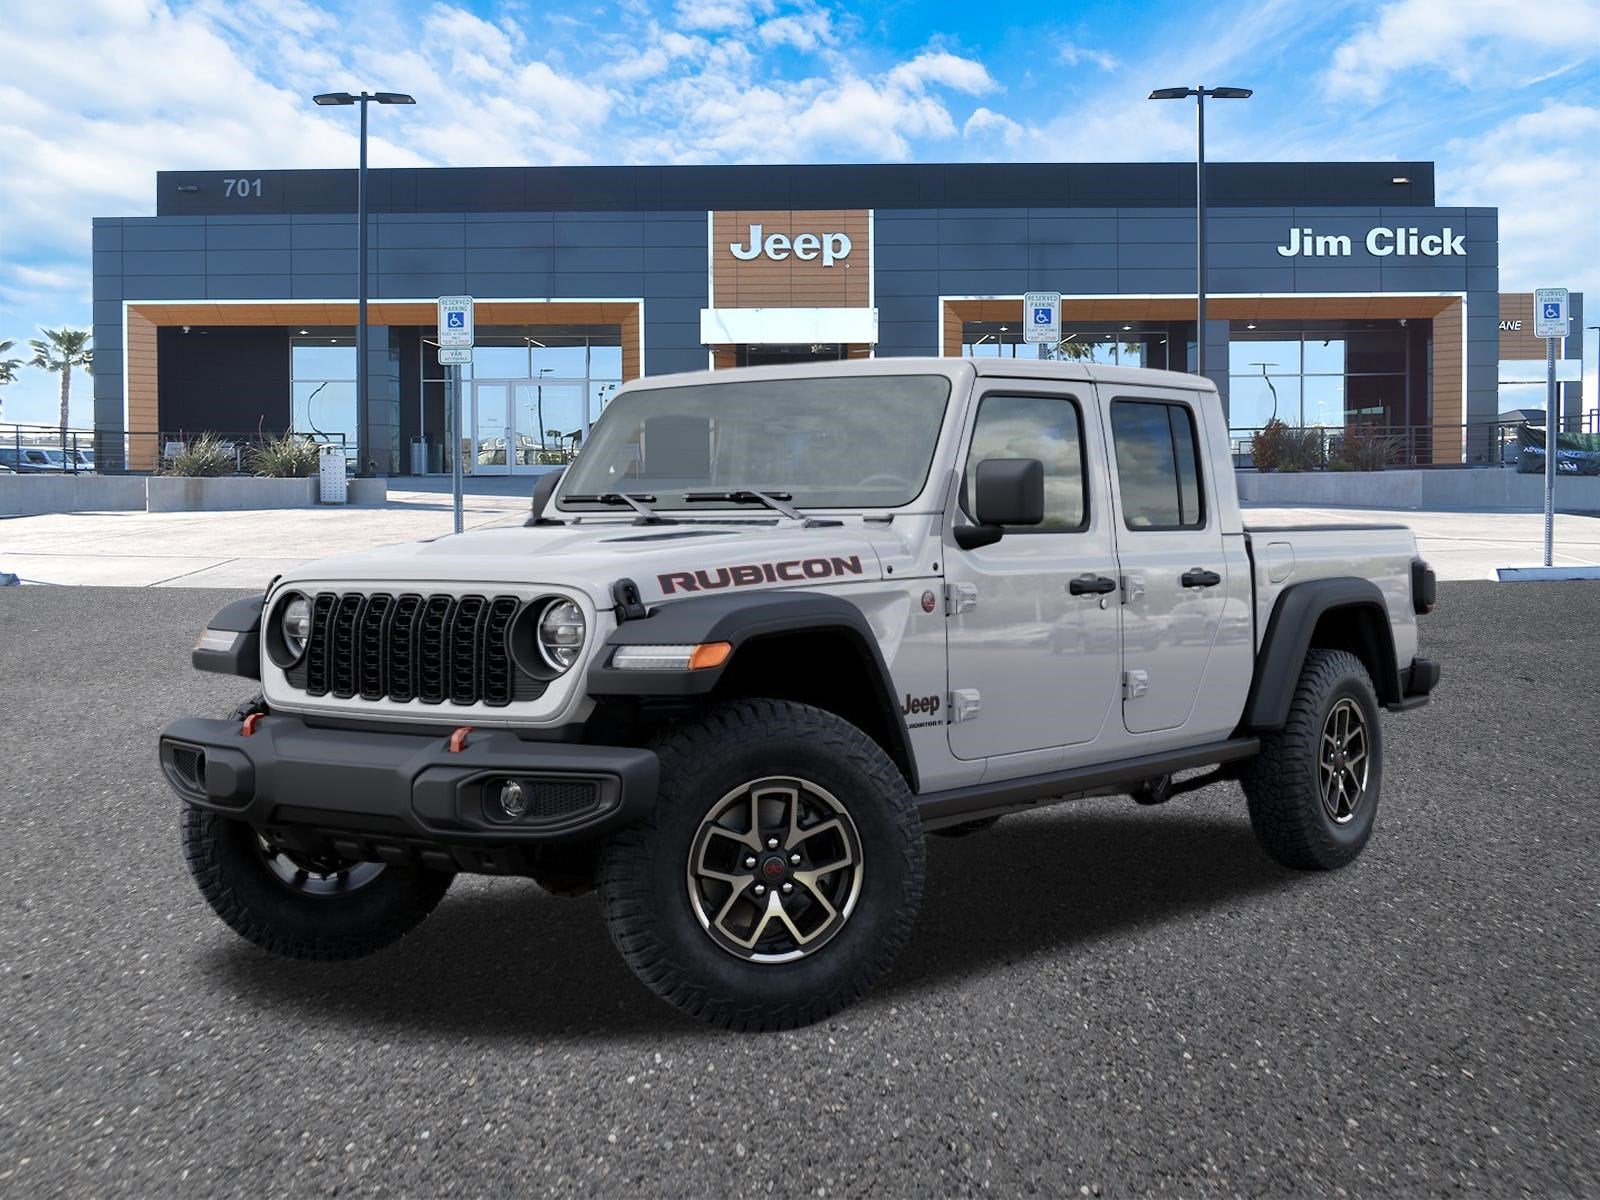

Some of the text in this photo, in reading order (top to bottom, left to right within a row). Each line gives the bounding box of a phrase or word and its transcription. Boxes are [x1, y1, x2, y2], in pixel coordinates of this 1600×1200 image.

[223, 178, 262, 197] 701
[729, 224, 852, 267] Jeep
[1277, 227, 1467, 257] Jim Click
[657, 555, 863, 595] RUBICON
[902, 693, 940, 715] Jeep
